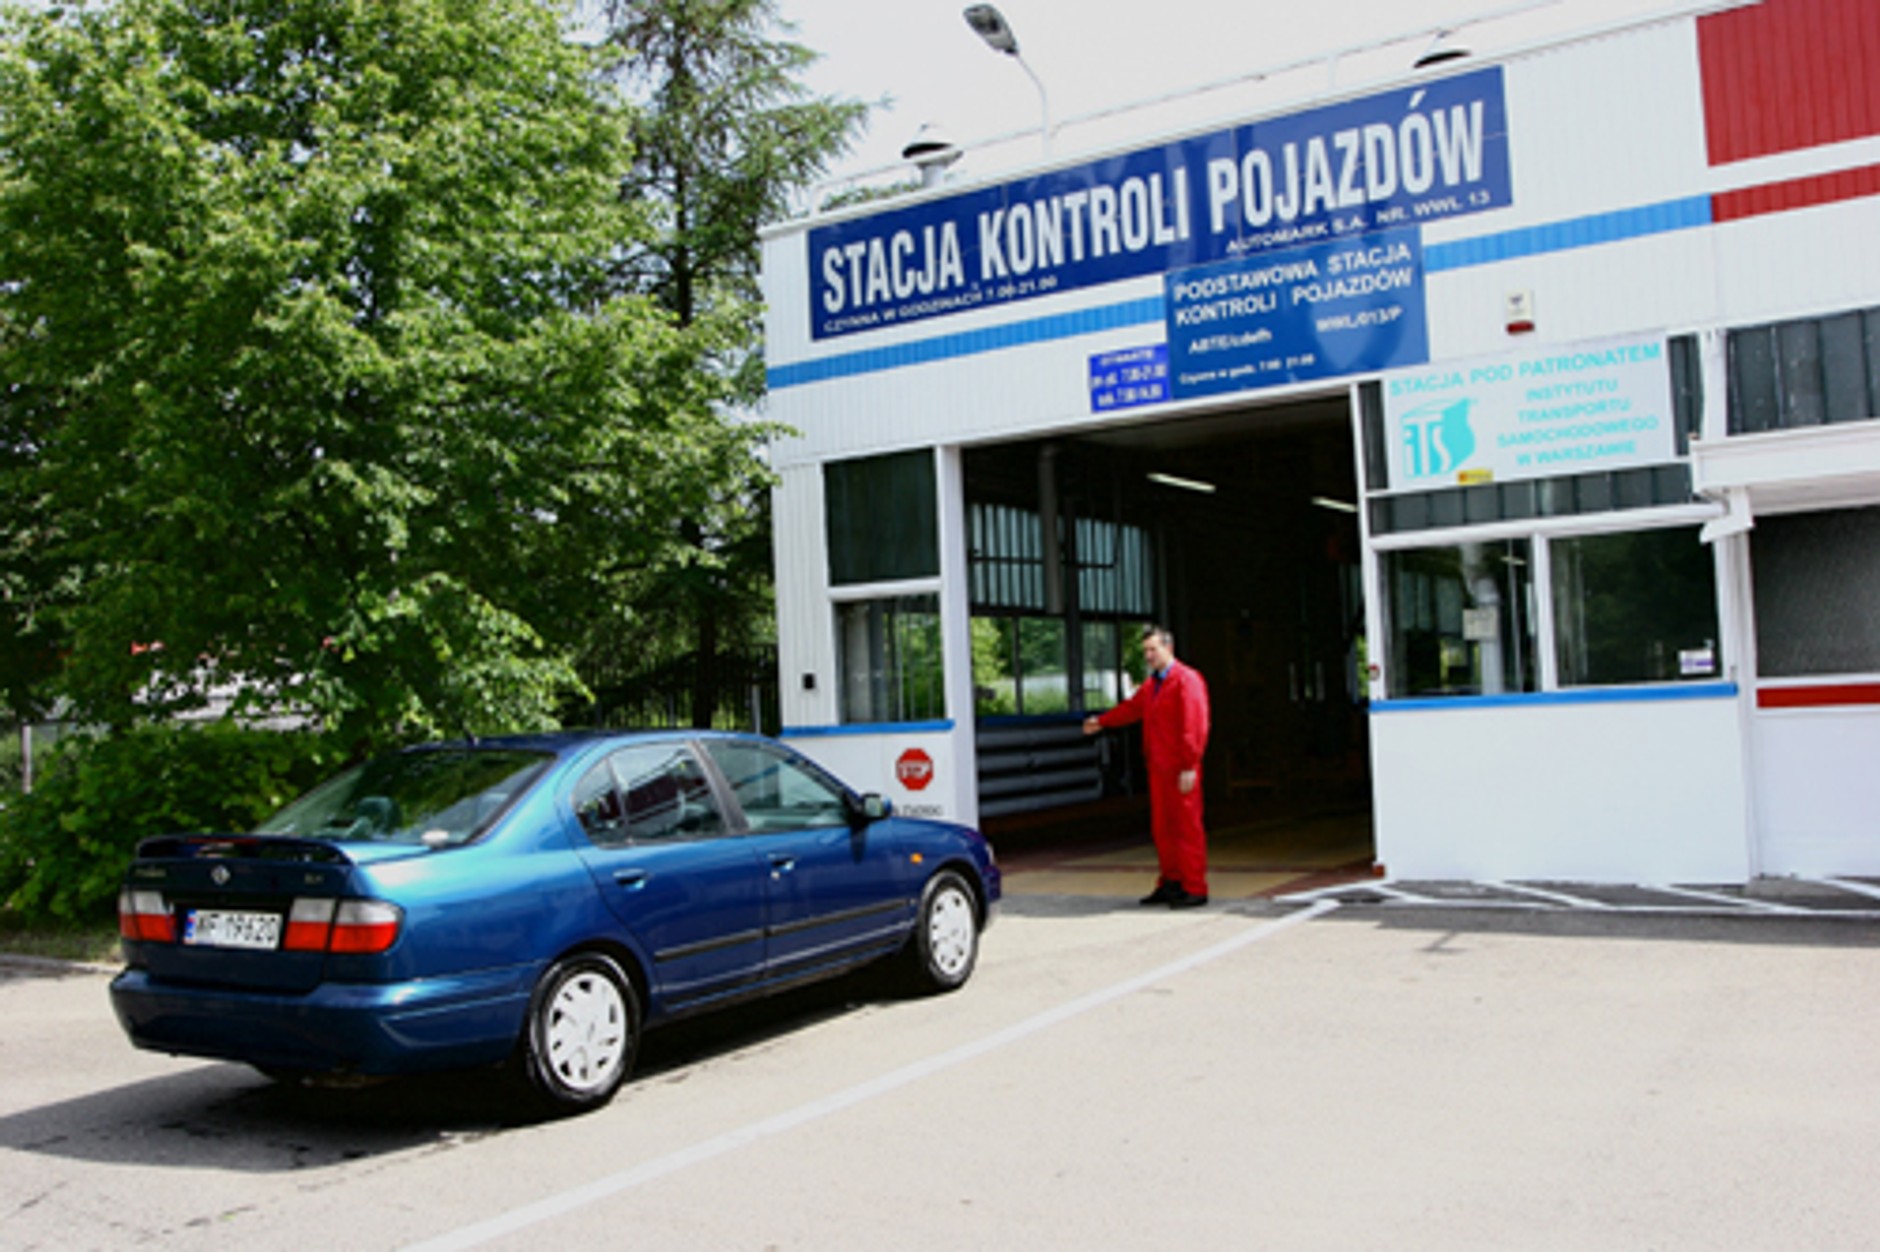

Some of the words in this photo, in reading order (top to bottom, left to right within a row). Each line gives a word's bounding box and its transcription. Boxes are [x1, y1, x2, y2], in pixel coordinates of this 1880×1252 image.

[823, 226, 964, 313] STACJA
[980, 165, 1190, 281] KONTROLI
[1209, 90, 1484, 231] POJAZDÓW
[1226, 222, 1329, 253] AUTOMARK
[1469, 190, 1491, 205] 13
[1173, 259, 1319, 302] PODSTAWOWA
[1327, 242, 1412, 275] STACJA
[1175, 292, 1277, 327] KONTROLI
[1291, 266, 1415, 305] POJAZDÓW
[824, 312, 881, 333] CZYNNA
[882, 308, 897, 322] W
[1389, 369, 1464, 397] STACJA
[1470, 363, 1513, 386] POD
[1518, 342, 1662, 378] PATRONATEM
[1526, 378, 1620, 402] INSTYTUTU
[1496, 415, 1660, 449] SAMOCHODOWEGO
[1517, 397, 1633, 424] TRANSPORTU
[1537, 440, 1637, 465] WARSZAWIE
